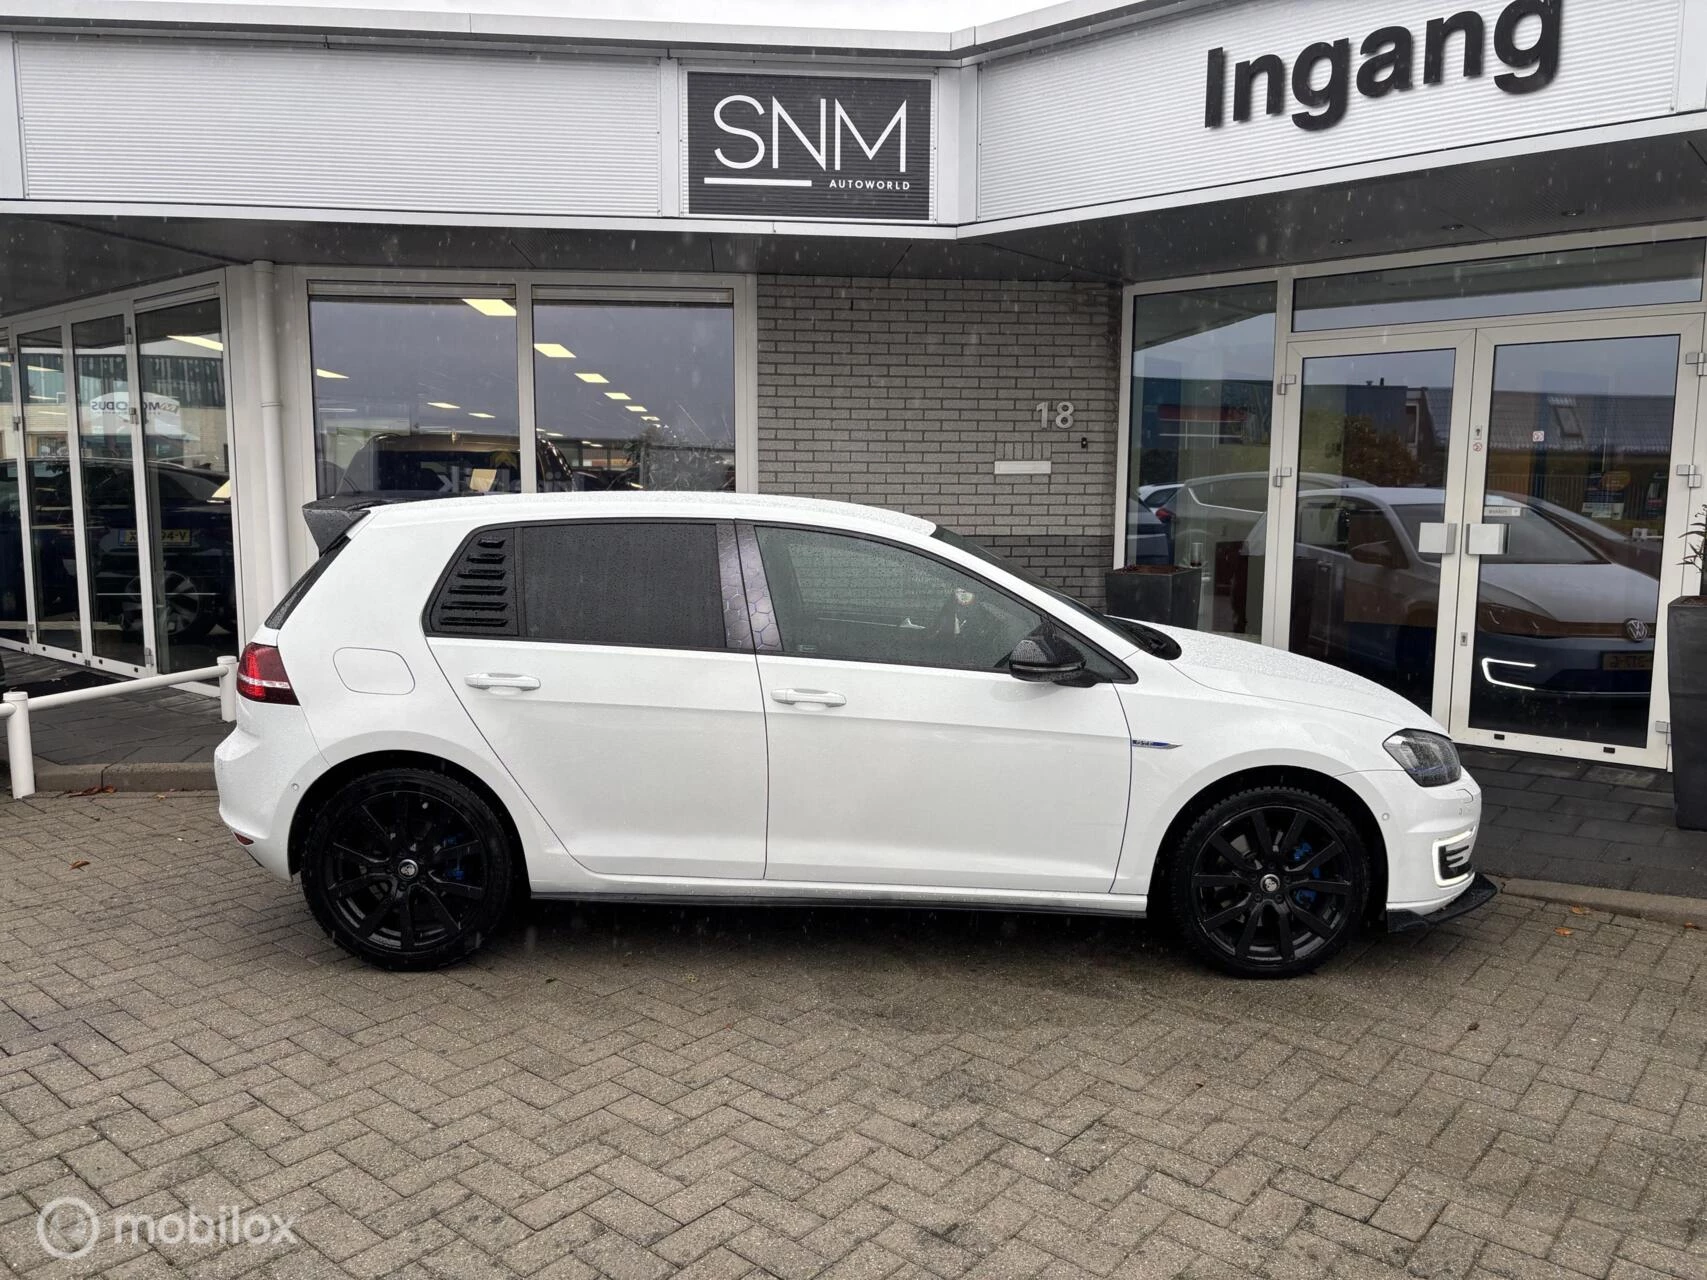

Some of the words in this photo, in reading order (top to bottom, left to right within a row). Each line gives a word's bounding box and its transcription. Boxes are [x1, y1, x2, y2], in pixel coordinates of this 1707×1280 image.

[1204, 0, 1563, 131] Ingang
[713, 94, 907, 173] SNM
[829, 179, 910, 190] AUTOWORLD
[1036, 401, 1074, 428] 18
